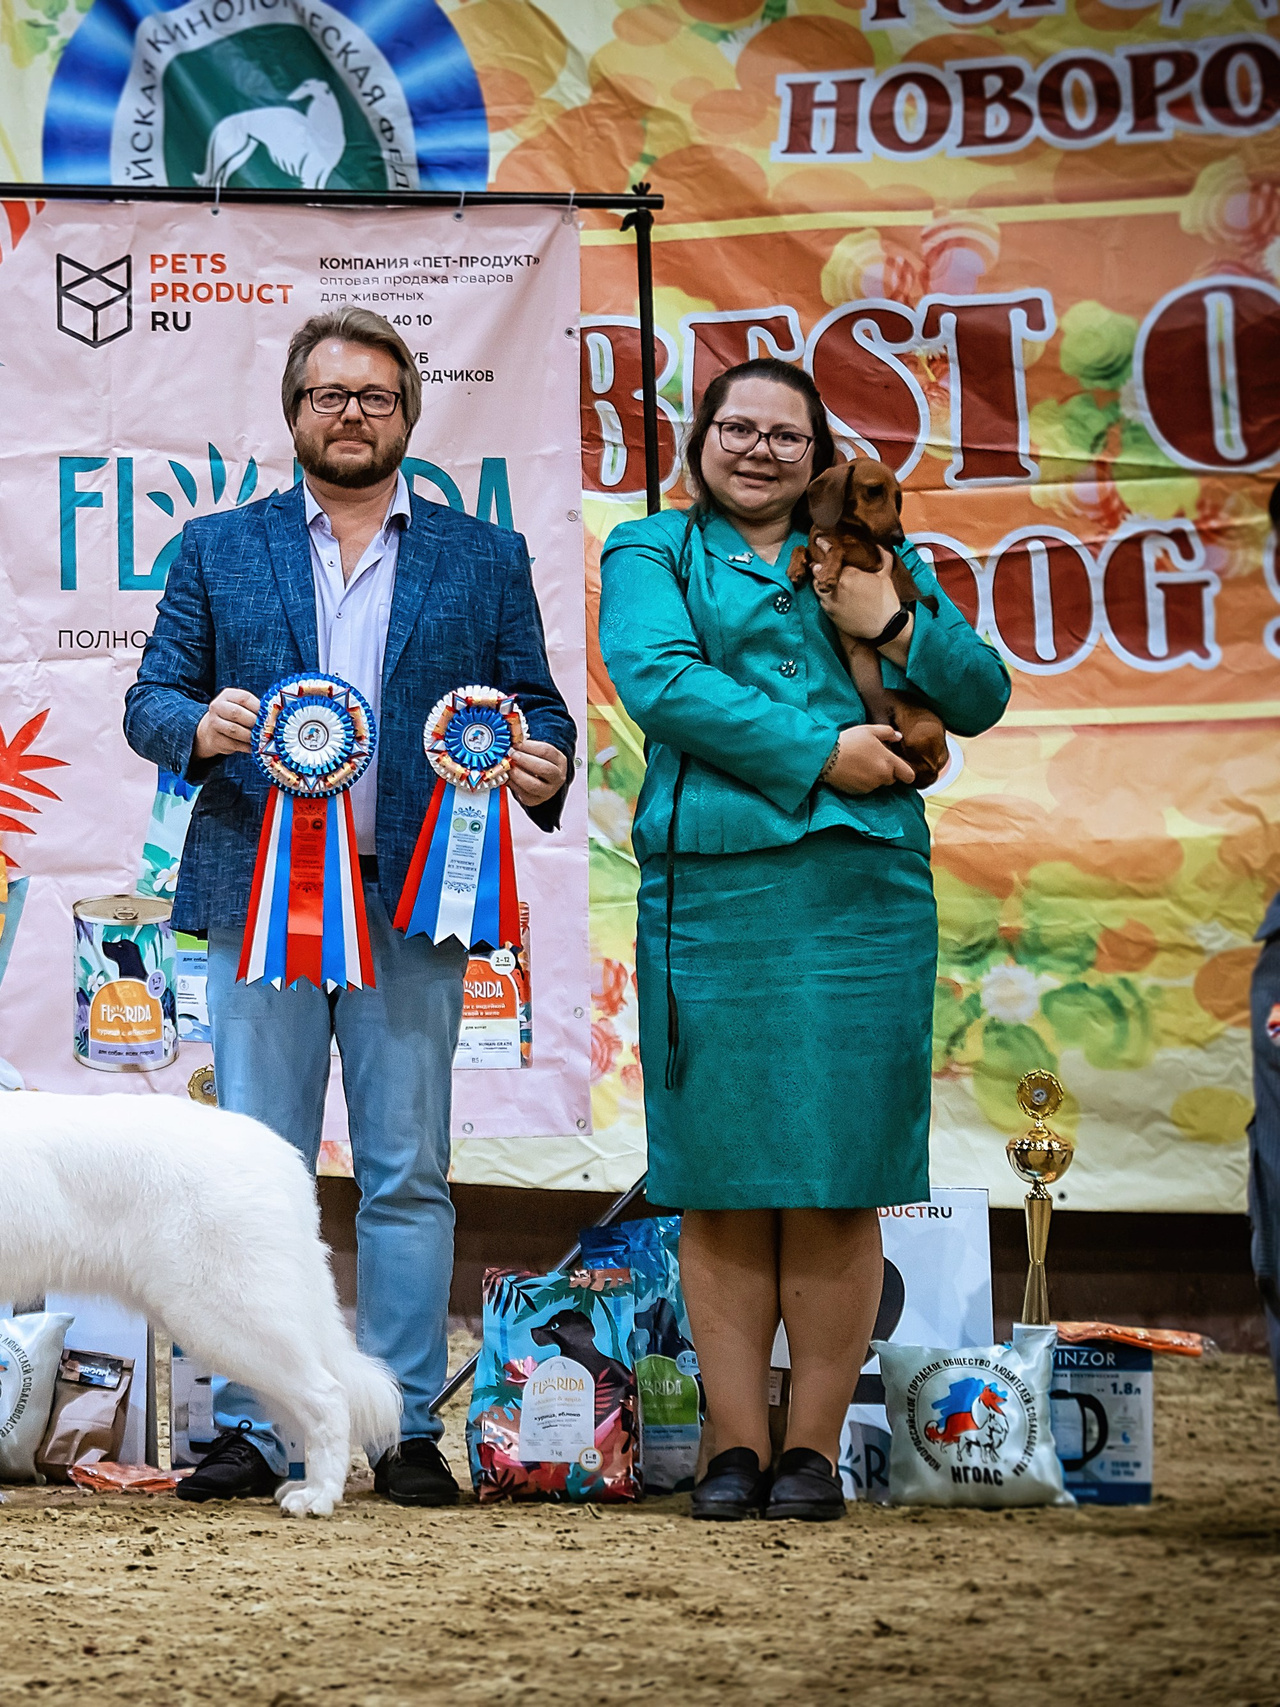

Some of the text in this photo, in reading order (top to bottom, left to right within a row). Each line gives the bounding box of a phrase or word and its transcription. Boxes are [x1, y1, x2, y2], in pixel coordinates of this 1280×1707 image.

[124, 58, 157, 187] ЙСКАЯ
[150, 252, 227, 275] PETS
[319, 254, 541, 270] КОМПАНИЯ «ПЕТ-ПРОДУКТ»
[320, 273, 514, 286] оптовая продажа товаров
[150, 281, 294, 306] PRODUCT
[321, 291, 425, 303] для животных
[151, 310, 192, 332] RU
[392, 314, 412, 326] 40
[415, 314, 433, 326] 10
[58, 629, 152, 650] ПОЛНО
[101, 1004, 152, 1023] FLORIDA
[878, 1206, 952, 1219] DUCTRU
[532, 1376, 585, 1396] FLORIDA
[640, 1379, 682, 1396] ORIDA
[908, 1362, 943, 1396] ГОРОДСКОЕ
[943, 1357, 991, 1368] ОБЩЕСТВО
[992, 1364, 1035, 1405] ЛЮБИТЕЛЕЙ
[951, 1465, 1004, 1487] НГОЛС
